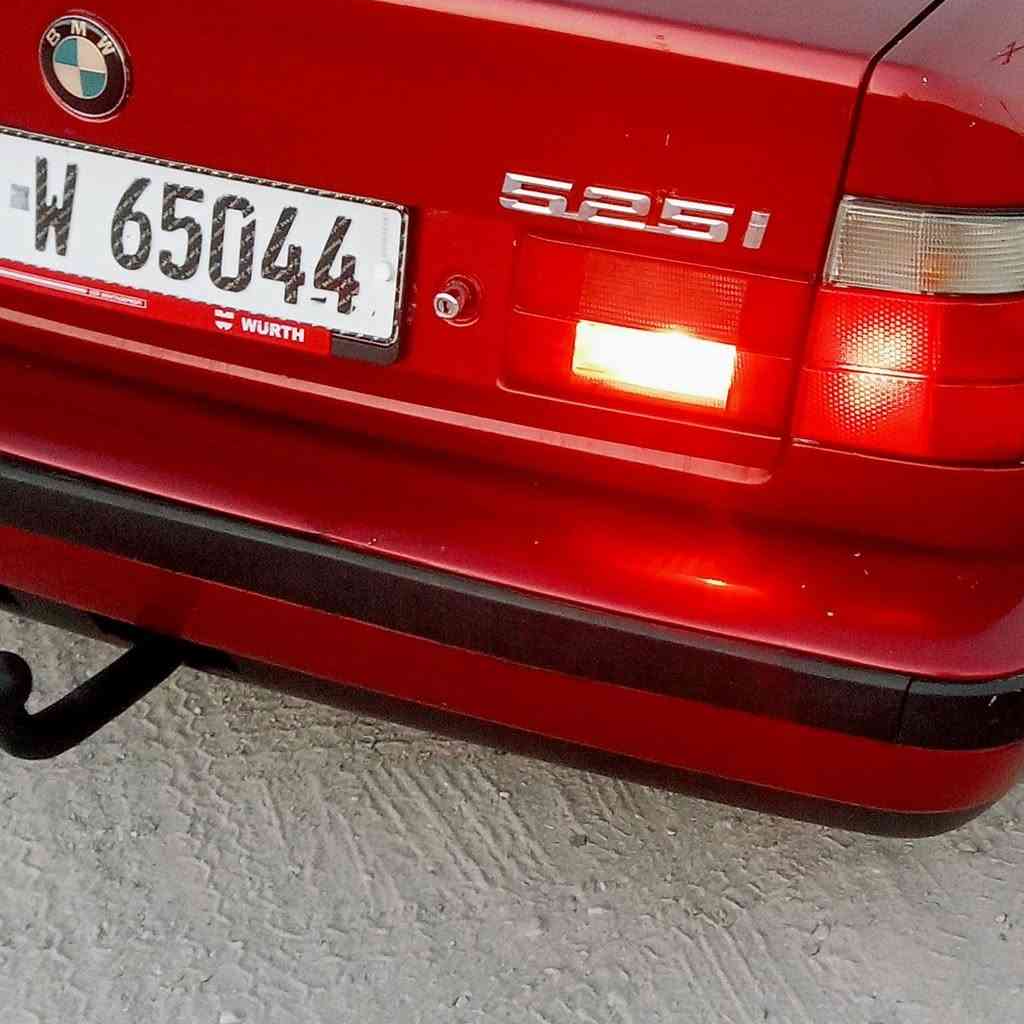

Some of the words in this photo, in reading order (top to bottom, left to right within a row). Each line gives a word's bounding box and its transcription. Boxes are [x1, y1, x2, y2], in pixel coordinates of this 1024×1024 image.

[46, 19, 115, 55] BMW
[35, 155, 77, 256] W
[110, 177, 361, 315] 65044
[499, 172, 770, 249] 525i
